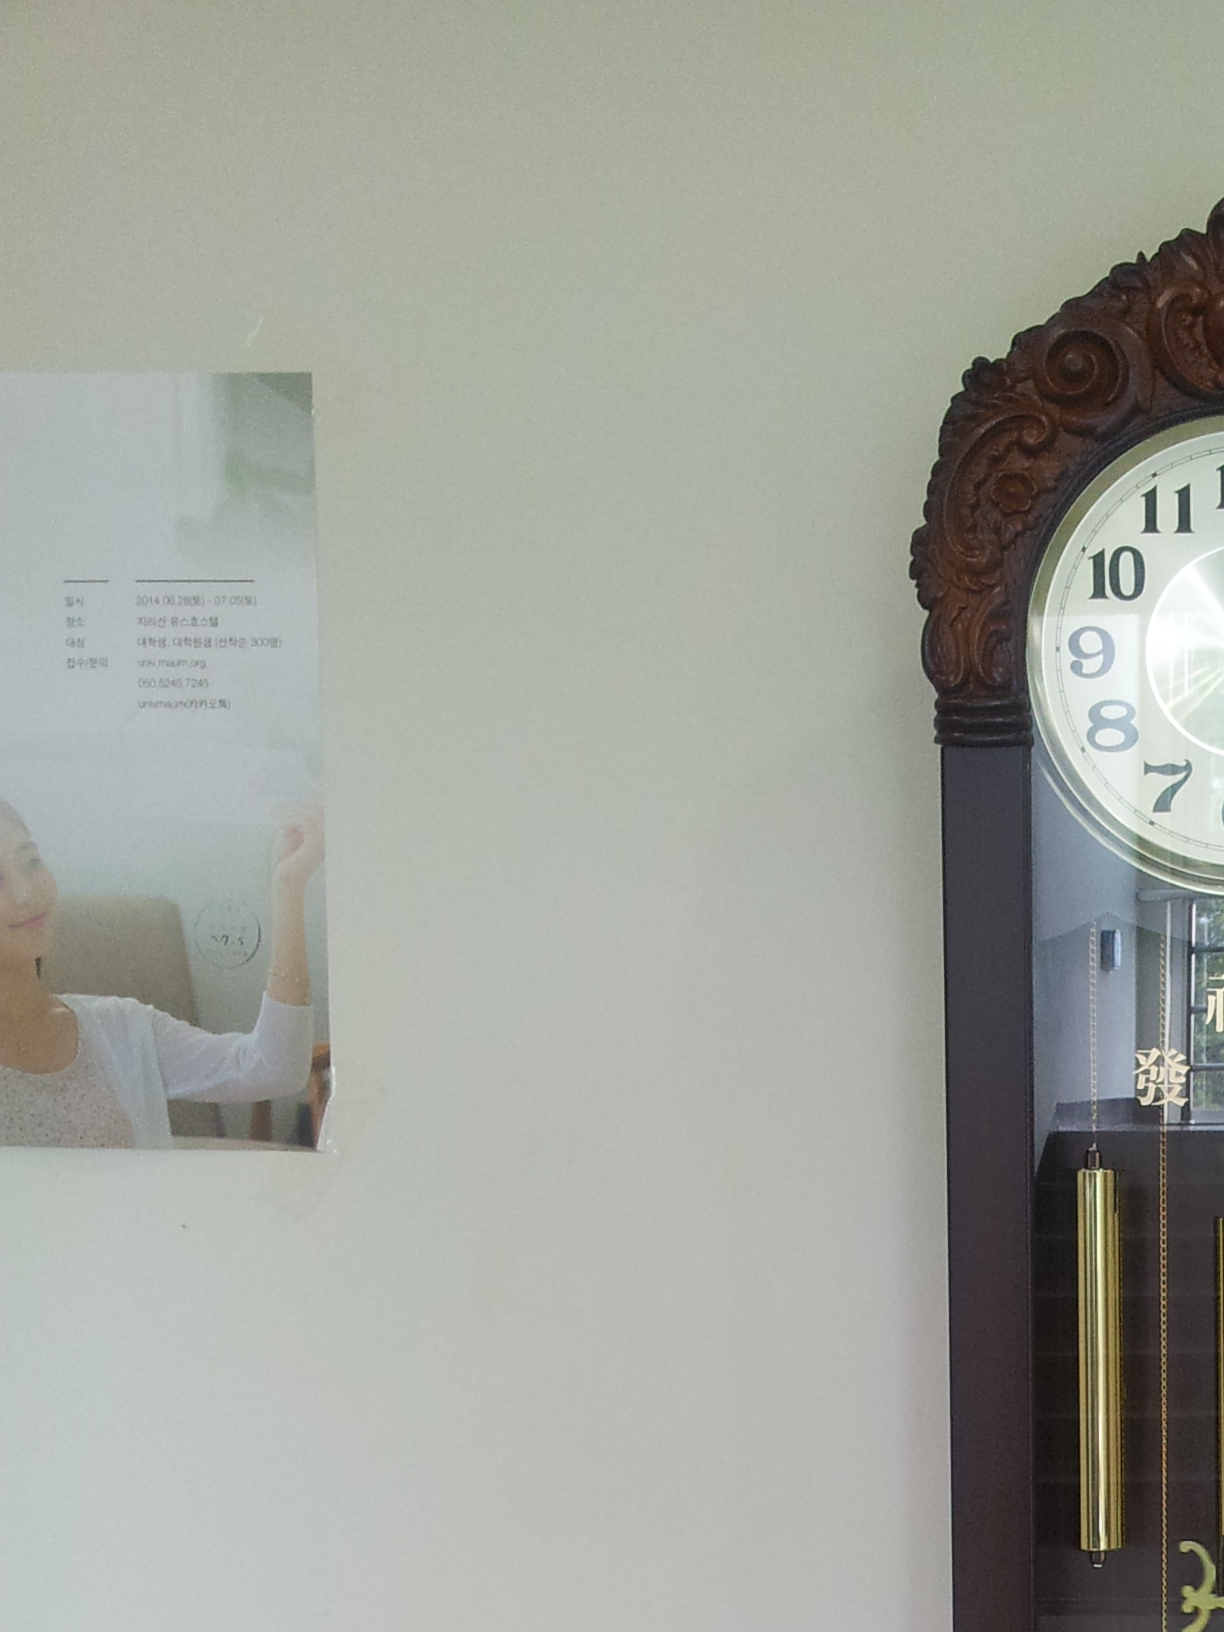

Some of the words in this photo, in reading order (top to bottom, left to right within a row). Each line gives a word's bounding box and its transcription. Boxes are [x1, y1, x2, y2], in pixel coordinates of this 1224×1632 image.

[1140, 482, 1196, 534] 11
[1088, 545, 1146, 602] 10
[137, 615, 167, 628] 지리산
[170, 615, 219, 628] 유스호스텔
[1067, 626, 1116, 679] 9
[1086, 699, 1139, 753] 8
[1143, 759, 1193, 814] 7
